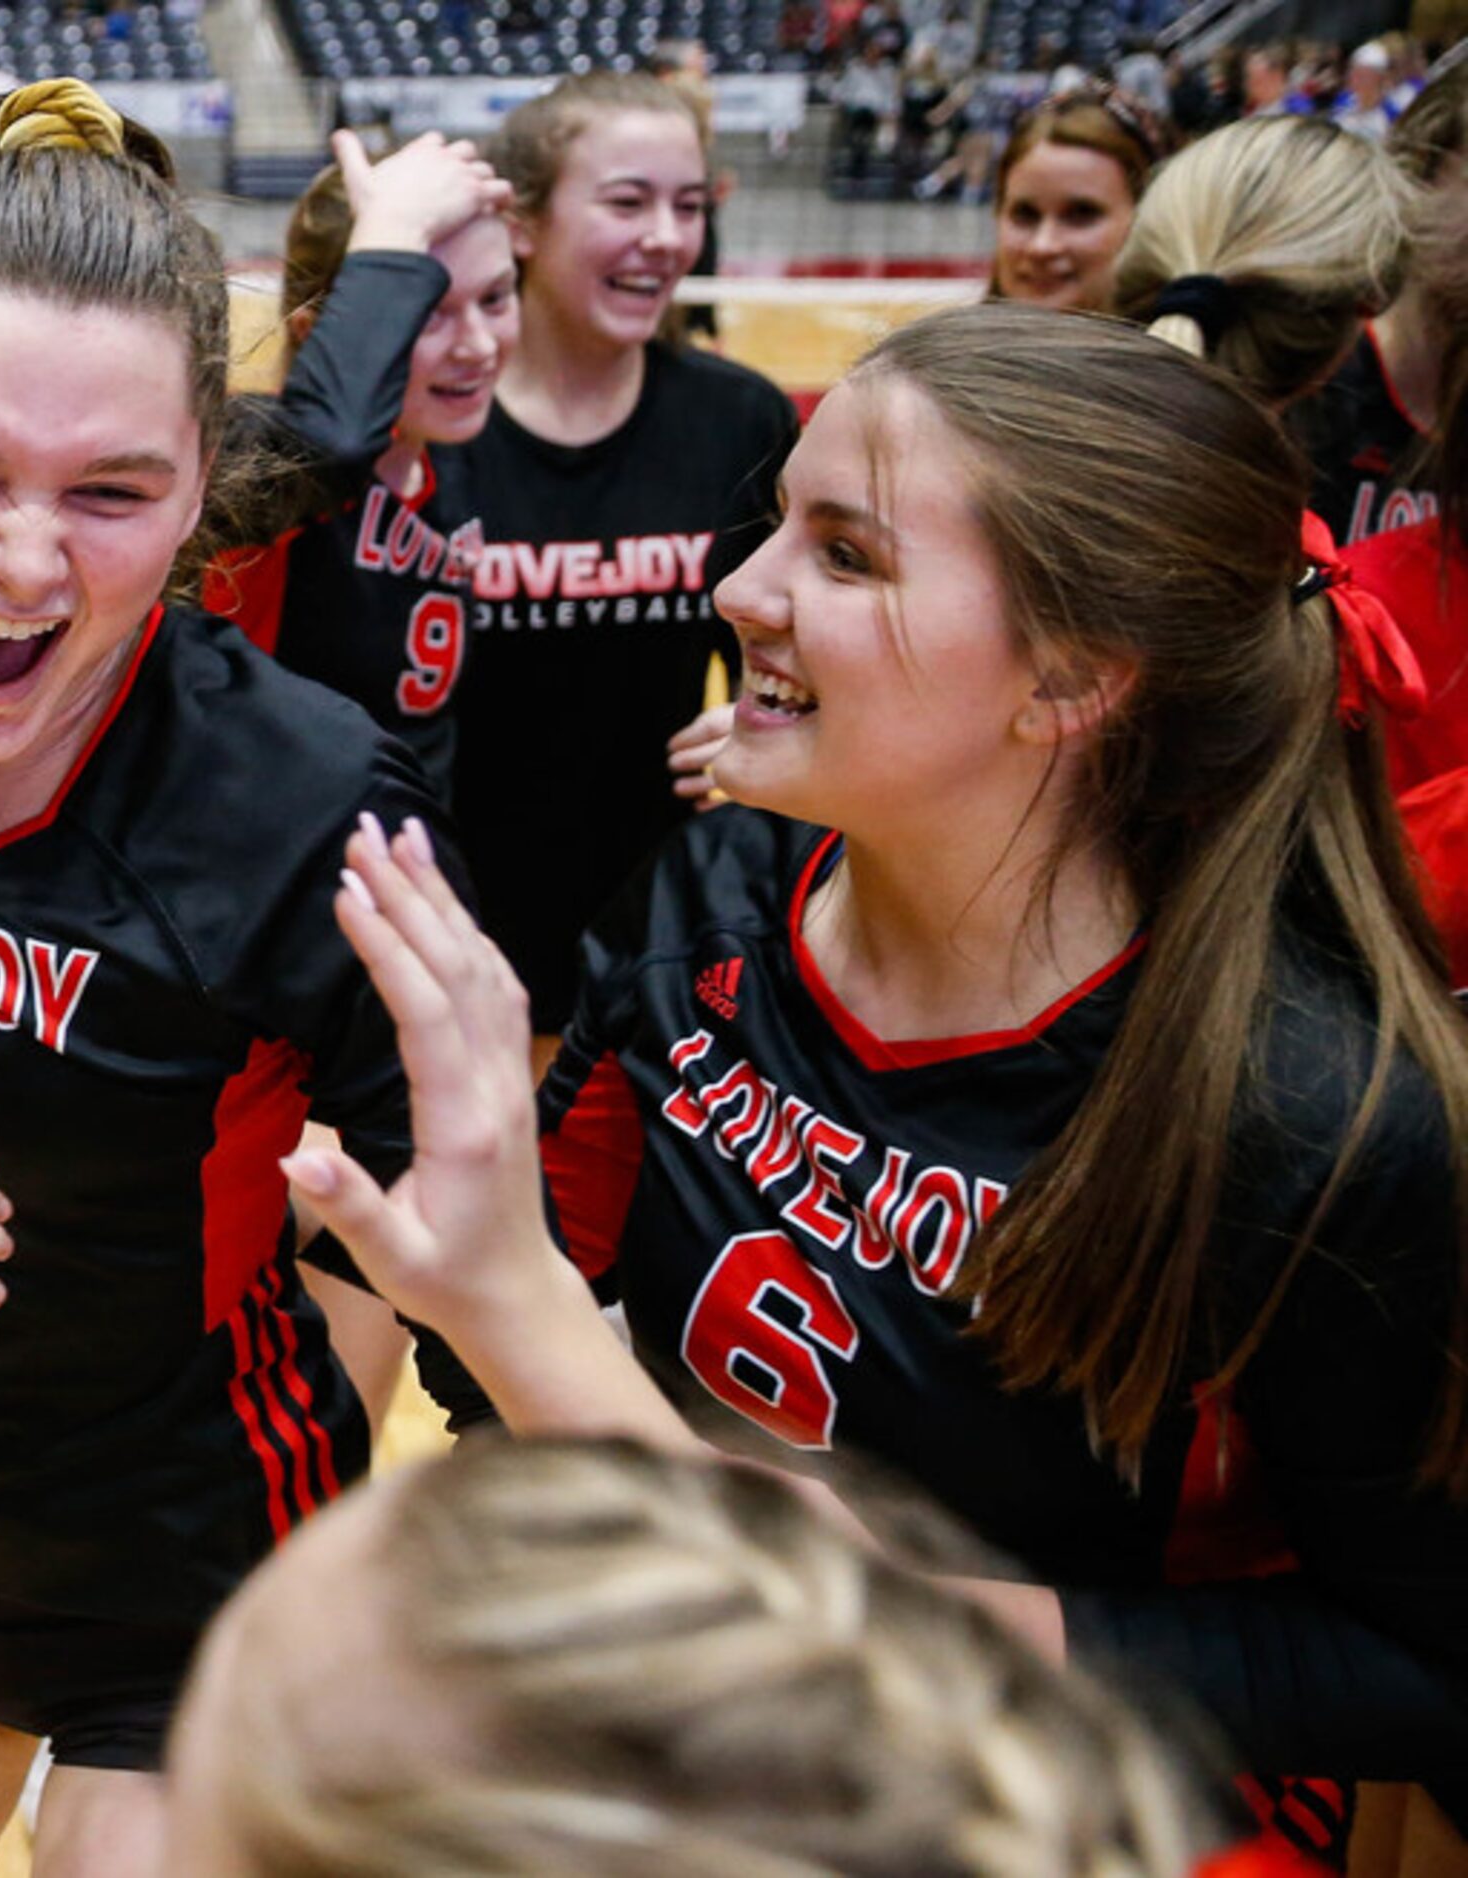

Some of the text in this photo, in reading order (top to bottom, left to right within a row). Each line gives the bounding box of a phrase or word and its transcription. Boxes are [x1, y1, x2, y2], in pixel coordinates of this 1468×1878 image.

[473, 532, 714, 600] OVEJOY
[395, 591, 465, 717] 9
[662, 1029, 1009, 1319] LOVEJO
[679, 1228, 860, 1452] 6
